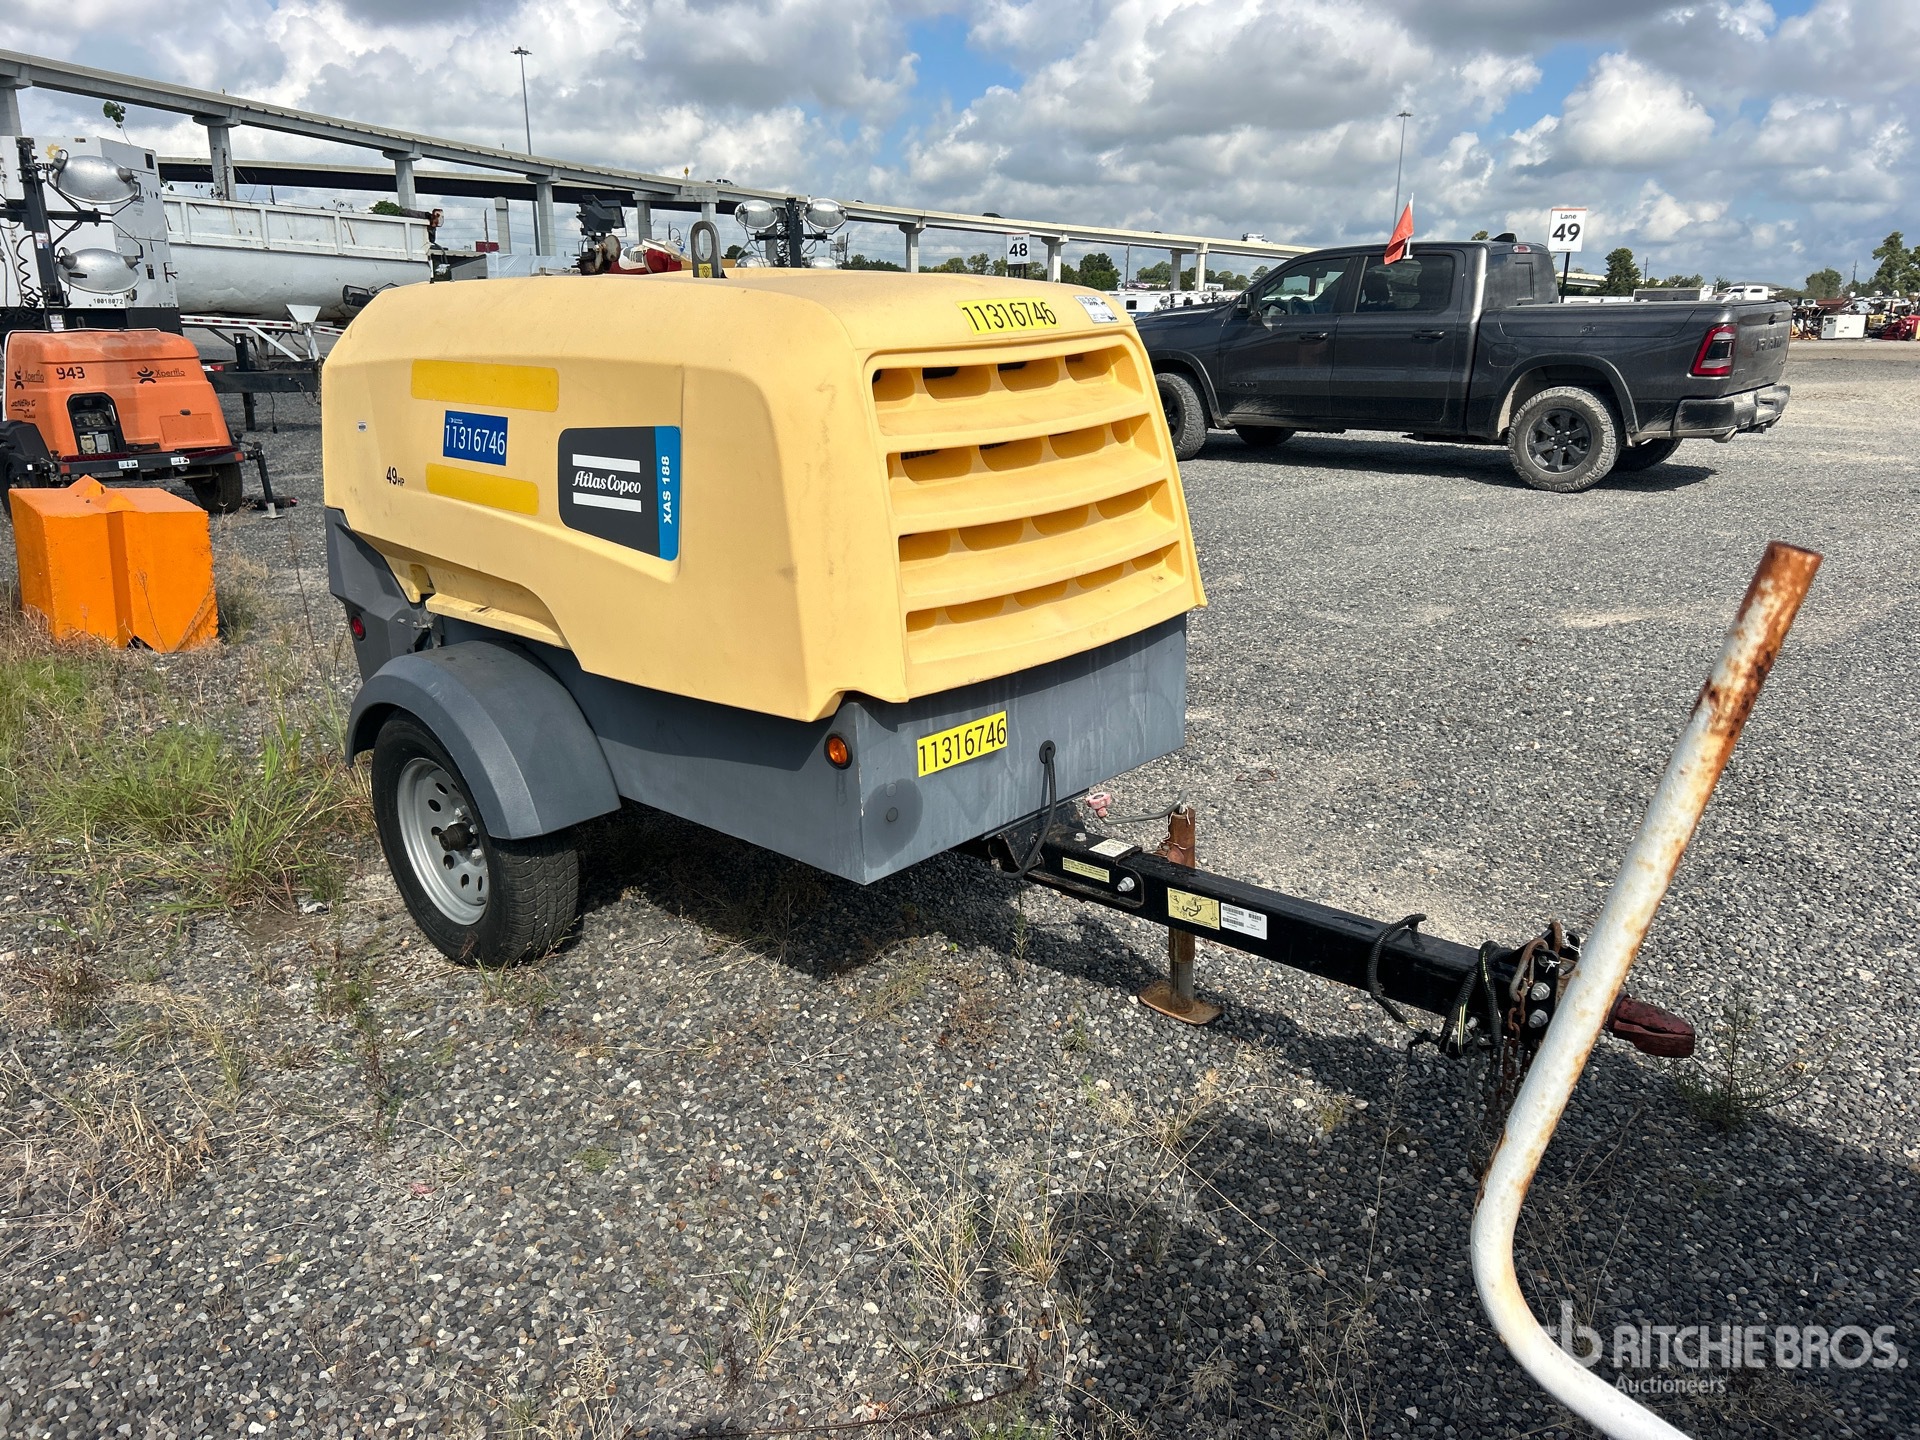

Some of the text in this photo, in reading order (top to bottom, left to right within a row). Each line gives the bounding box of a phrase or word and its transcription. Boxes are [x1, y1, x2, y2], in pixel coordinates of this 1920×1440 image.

[1552, 223, 1581, 242] 49
[1009, 243, 1028, 257] 48
[961, 302, 1057, 331] 11316746
[56, 366, 85, 380] 943
[445, 425, 506, 456] 11316746
[572, 470, 642, 495] Atlas Copco
[661, 456, 673, 525] XAS 188
[919, 717, 1007, 772] 11316746
